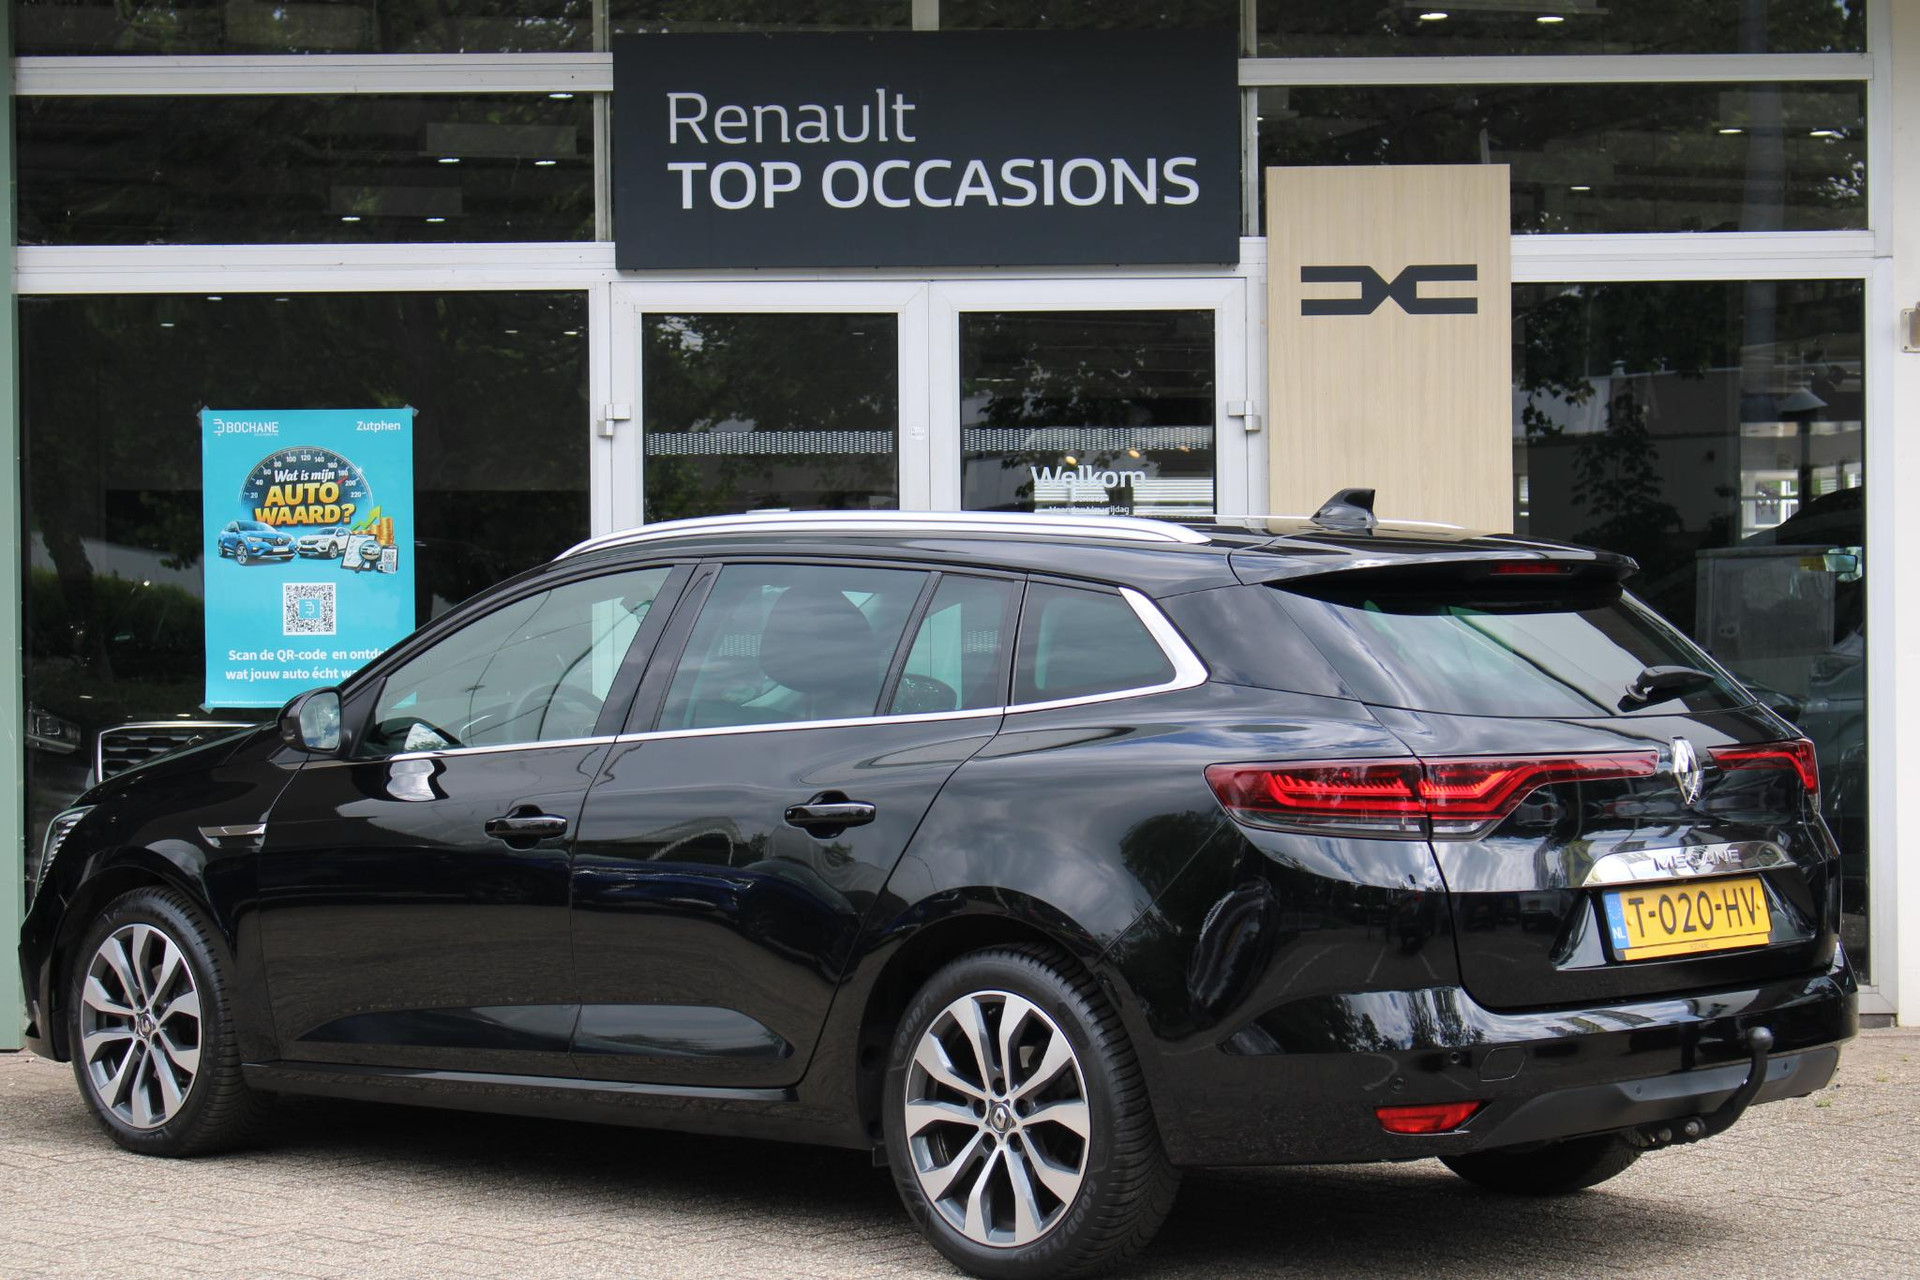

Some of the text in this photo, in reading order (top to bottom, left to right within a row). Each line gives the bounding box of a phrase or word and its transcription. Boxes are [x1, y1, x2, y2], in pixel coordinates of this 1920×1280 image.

[666, 88, 916, 144] Renault
[667, 156, 1200, 210] TOP OCCASIONS
[226, 421, 279, 433] BOCHANE
[356, 420, 401, 433] Zutphen
[274, 469, 335, 482] Wat is mijn
[1031, 465, 1146, 488] Welkom
[264, 482, 340, 507] AUTO
[254, 503, 356, 526] WAARD?
[228, 648, 388, 662] Scan de QR-code en ontd
[225, 669, 248, 679] wat
[249, 668, 280, 682] jouw
[282, 669, 310, 679] auto
[312, 666, 339, 679] écht
[1653, 849, 1741, 871] MEGANE
[1628, 886, 1757, 938] T-020-HV
[1612, 927, 1627, 940] NL
